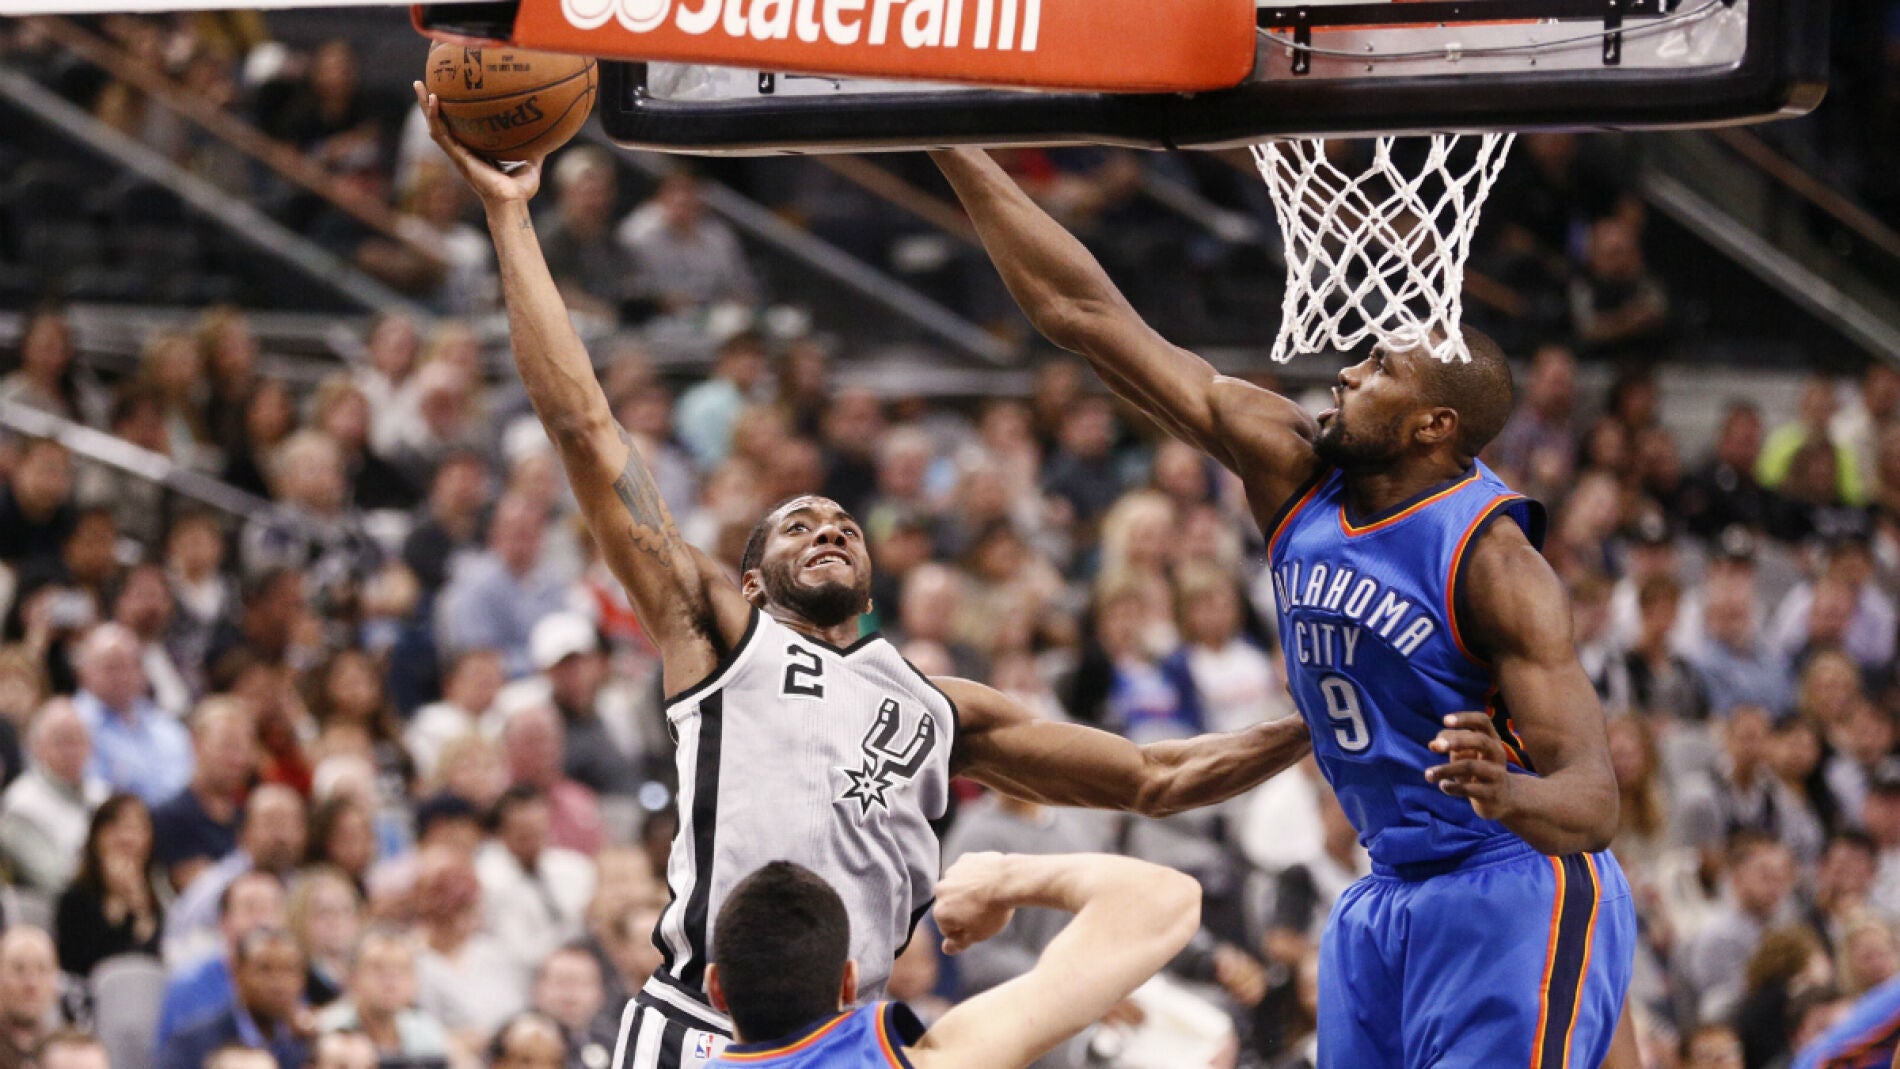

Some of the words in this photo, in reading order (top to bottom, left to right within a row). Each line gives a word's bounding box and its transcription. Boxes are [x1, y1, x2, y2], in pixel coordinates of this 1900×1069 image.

[458, 95, 544, 134] SPAL
[1296, 621, 1360, 666] CITY
[783, 644, 824, 698] 2
[1320, 676, 1370, 751] 9
